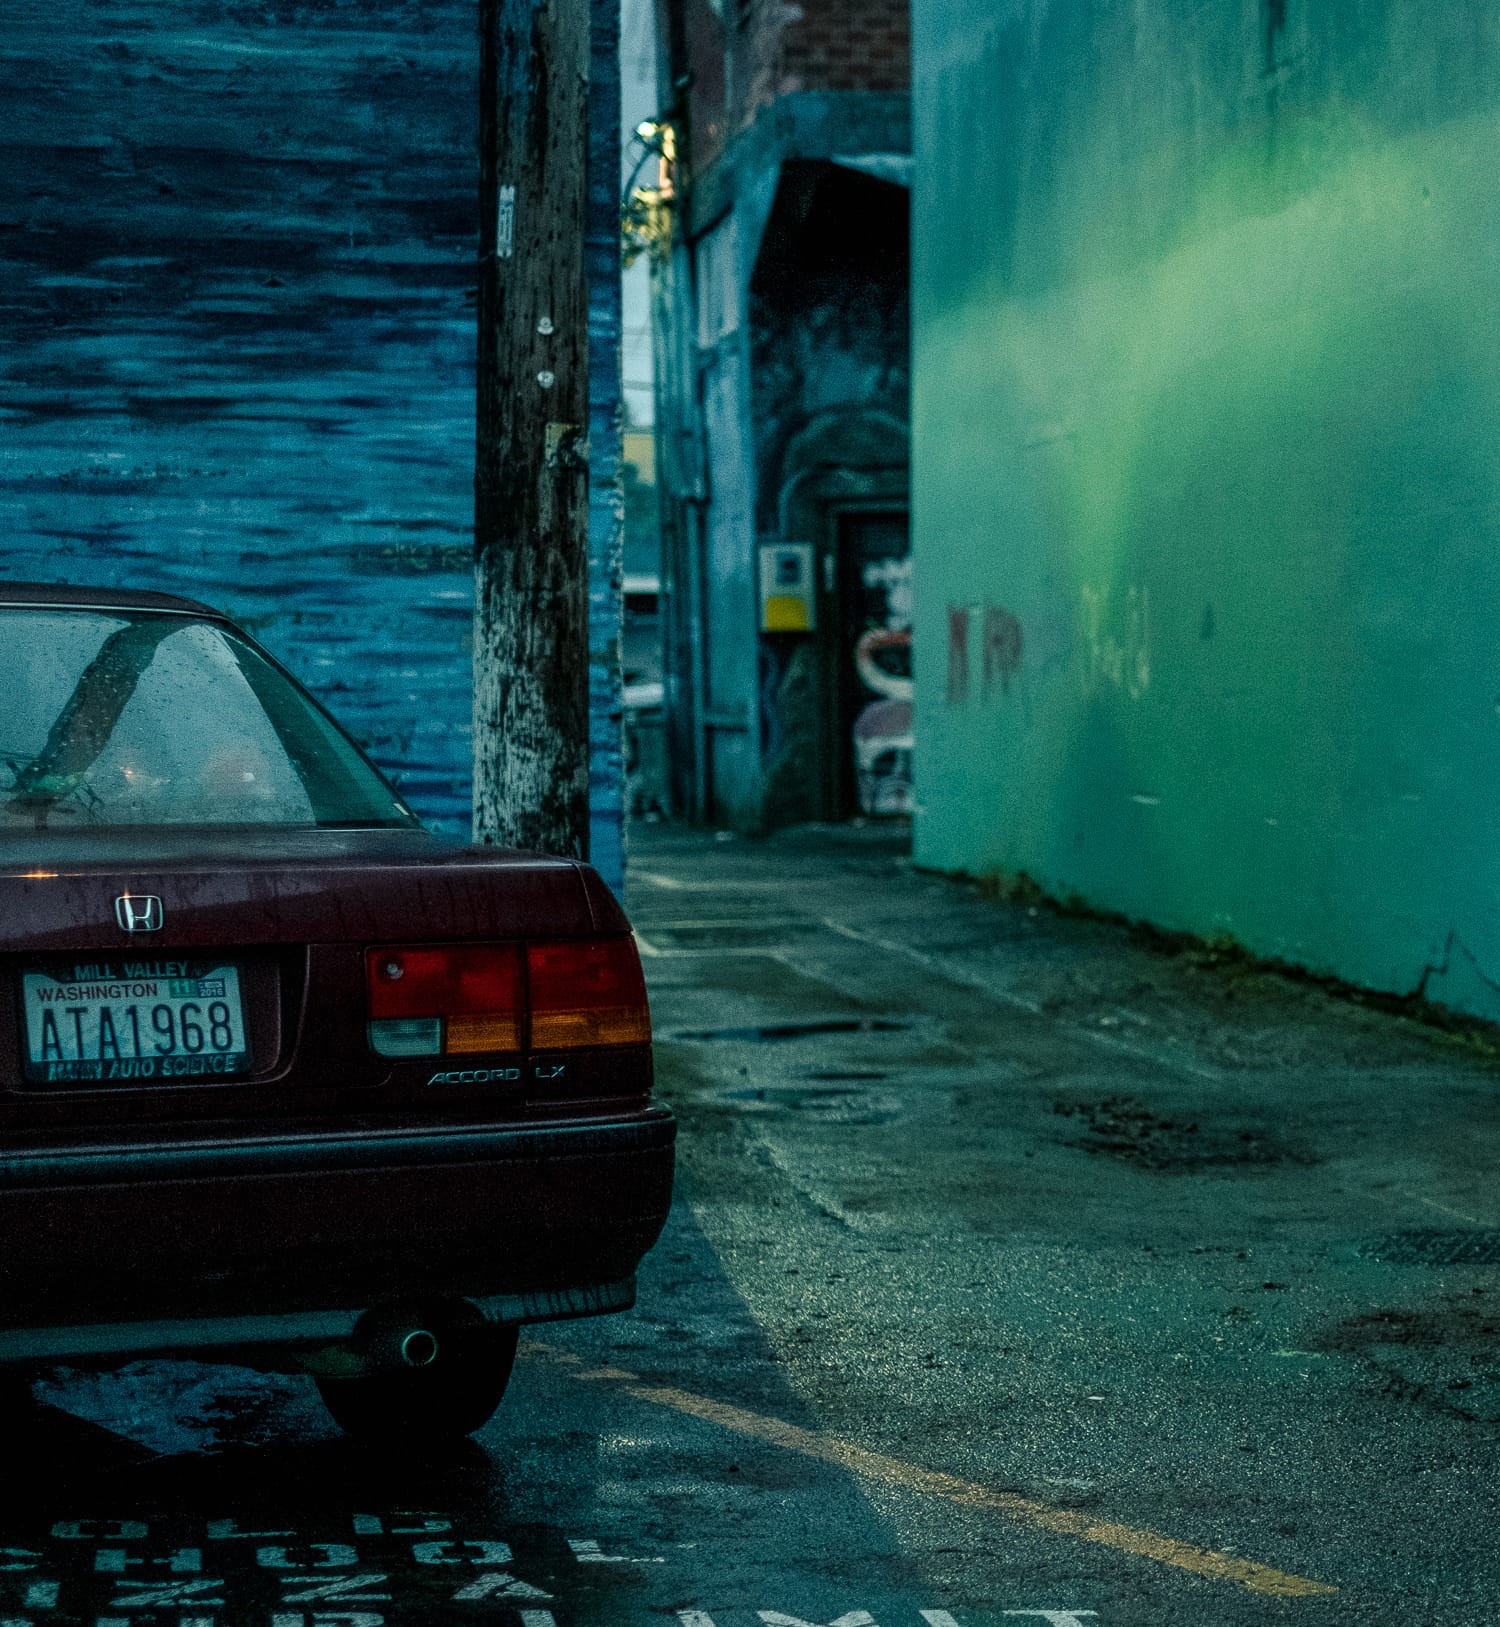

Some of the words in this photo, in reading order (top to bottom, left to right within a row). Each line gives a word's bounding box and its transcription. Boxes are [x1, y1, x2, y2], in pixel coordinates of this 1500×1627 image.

[73, 963, 117, 981] MILL
[123, 960, 189, 979] VALLEY
[37, 983, 158, 1001] WASHINGTON
[41, 1001, 232, 1061] ATA1968
[427, 1068, 521, 1086] ACCORD
[535, 1065, 566, 1079] LX
[50, 1512, 453, 1539] OLD
